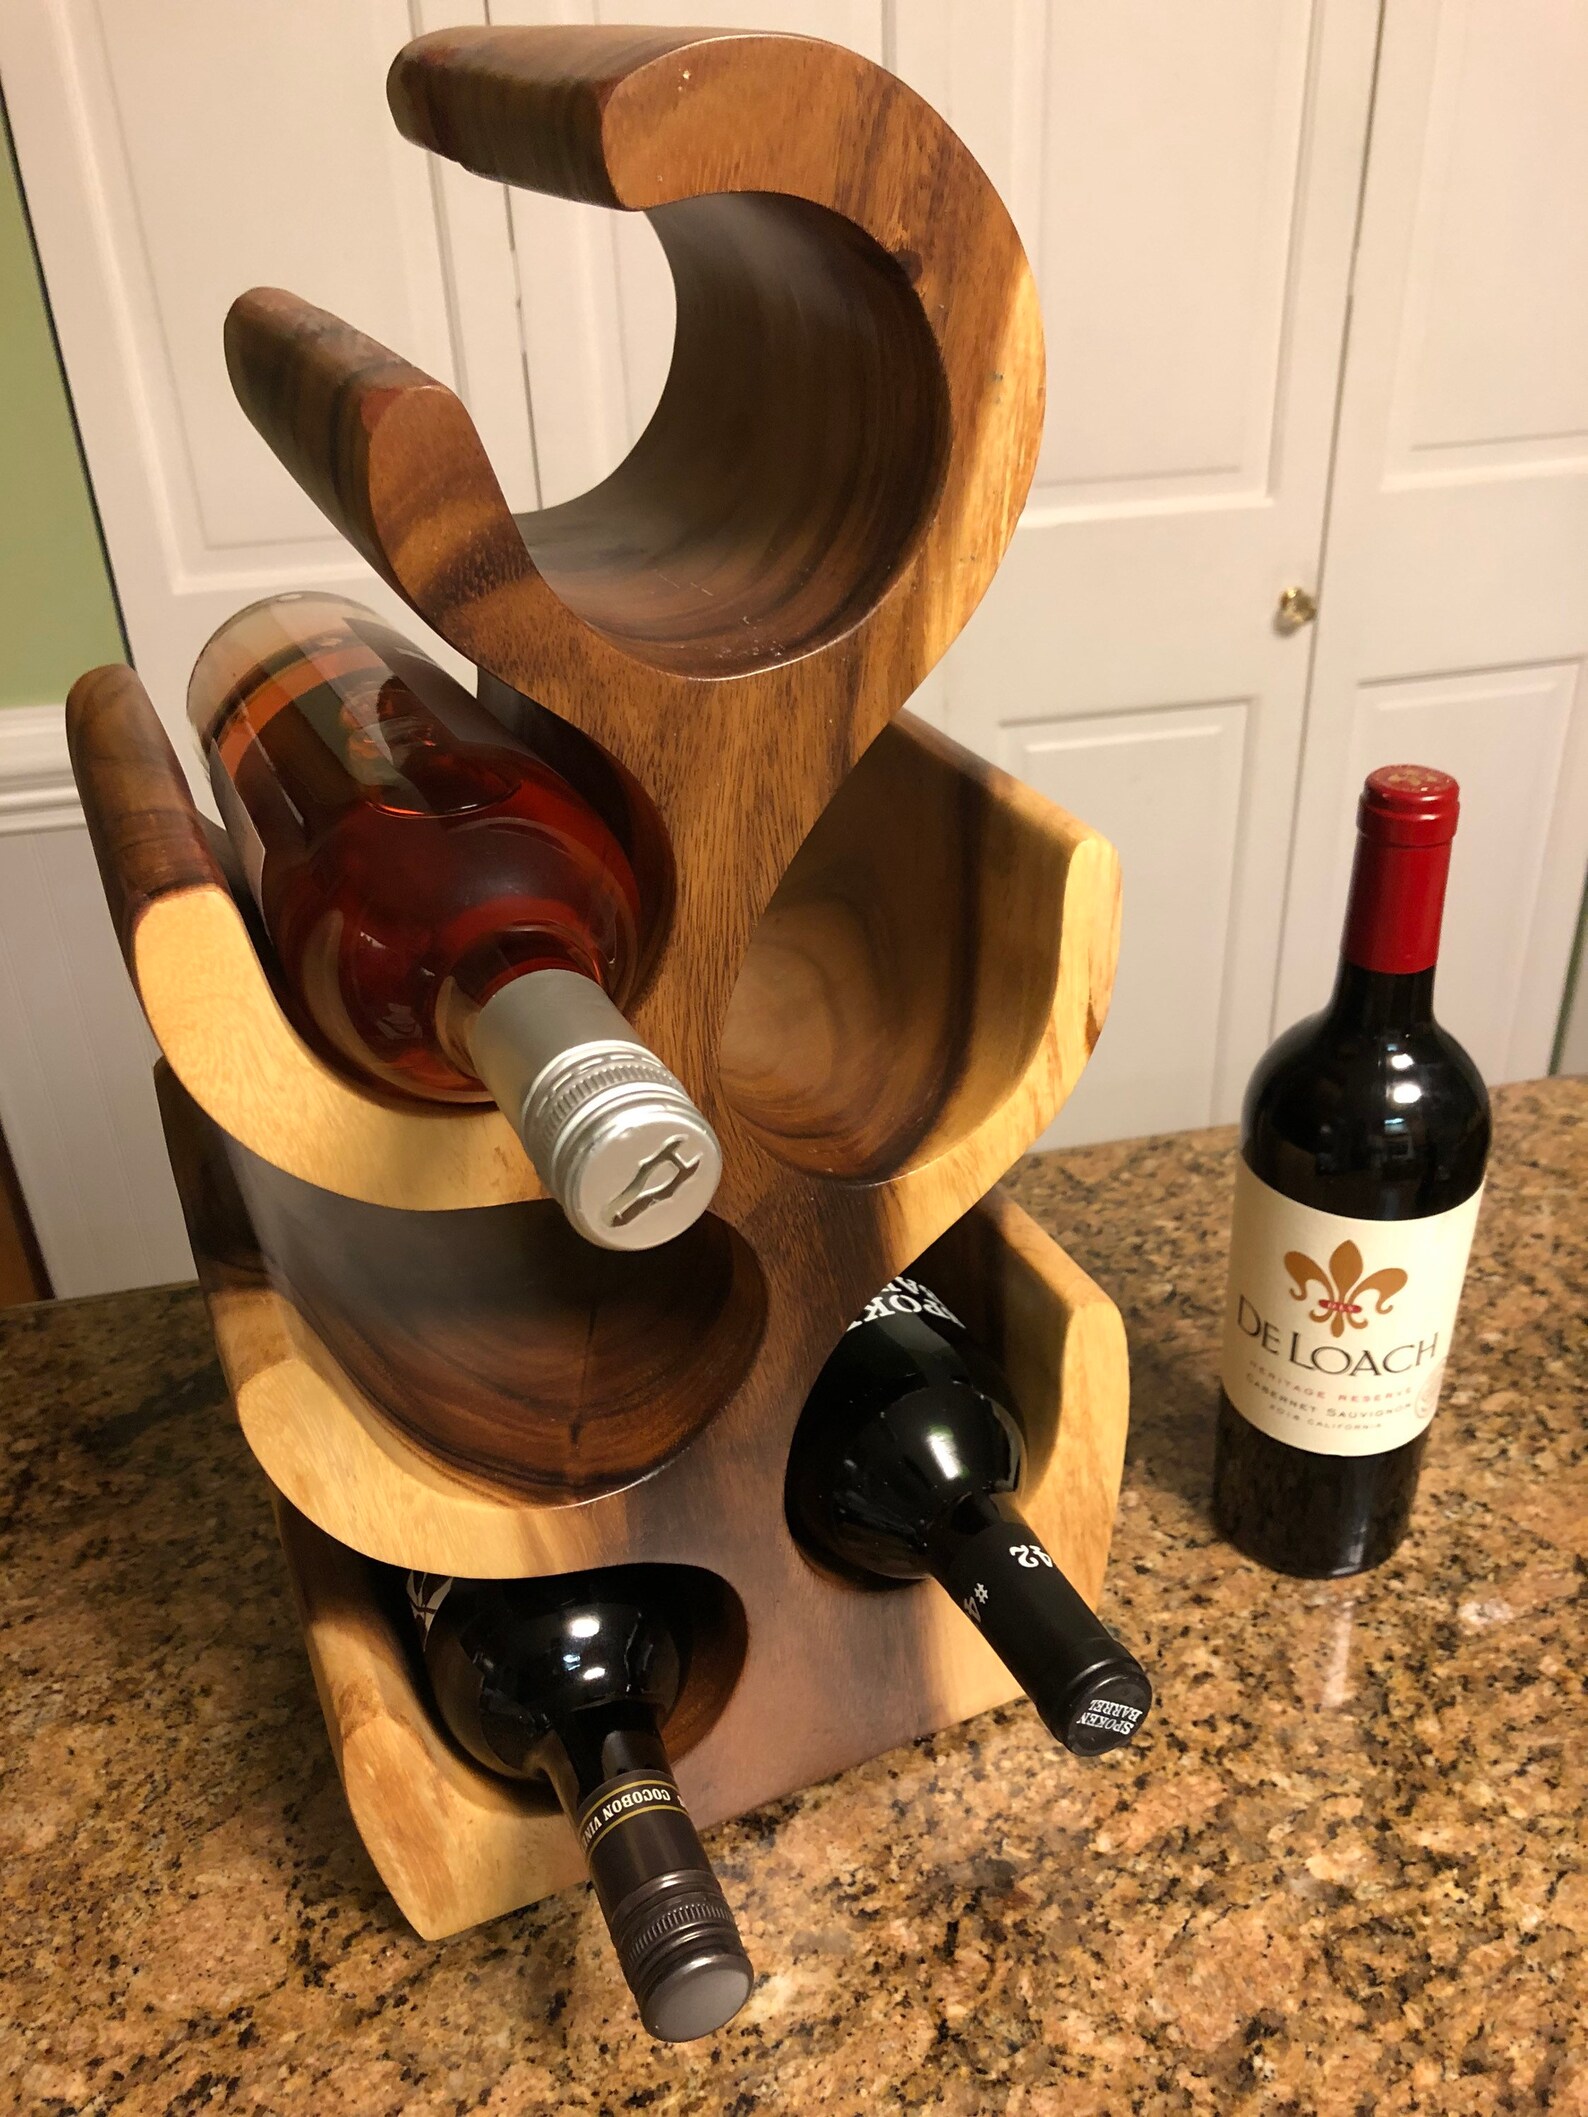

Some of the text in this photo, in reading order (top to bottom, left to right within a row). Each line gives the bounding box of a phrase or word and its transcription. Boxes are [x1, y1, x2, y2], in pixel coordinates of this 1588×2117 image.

[1237, 1294, 1440, 1377] DE LOACH
[1246, 1372, 1412, 1419] CABERNET SAUVIGNON
[1249, 1360, 1327, 1400] HERITAGE
[1337, 1386, 1413, 1403] RESERVE
[1076, 1712, 1135, 1736] SPOKEN
[1090, 1699, 1143, 1723] BARREL
[602, 1788, 671, 1821] COCOBON
